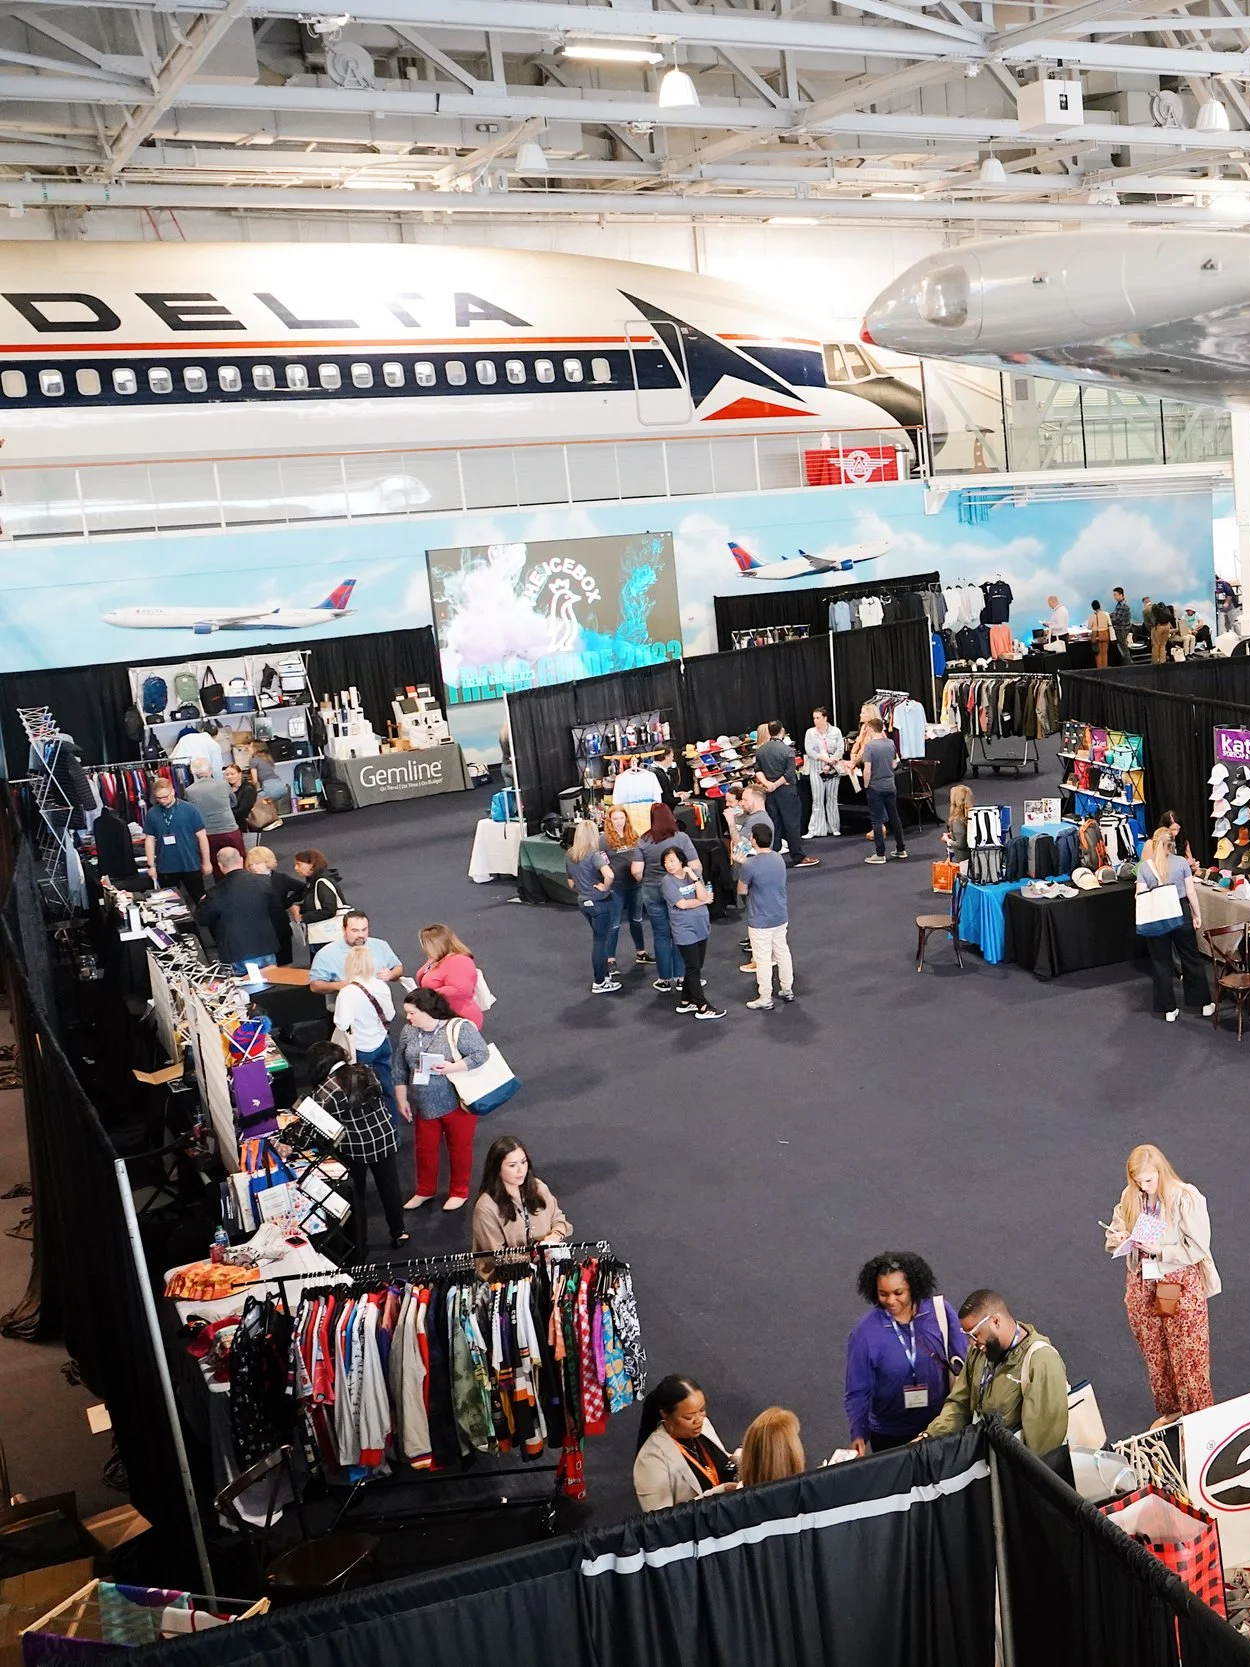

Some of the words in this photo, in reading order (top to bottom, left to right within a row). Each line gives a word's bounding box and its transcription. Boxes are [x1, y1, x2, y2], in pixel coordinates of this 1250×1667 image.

[0, 292, 533, 333] DELTA
[541, 556, 602, 605] ICEBOX
[360, 759, 442, 788] Gemline
